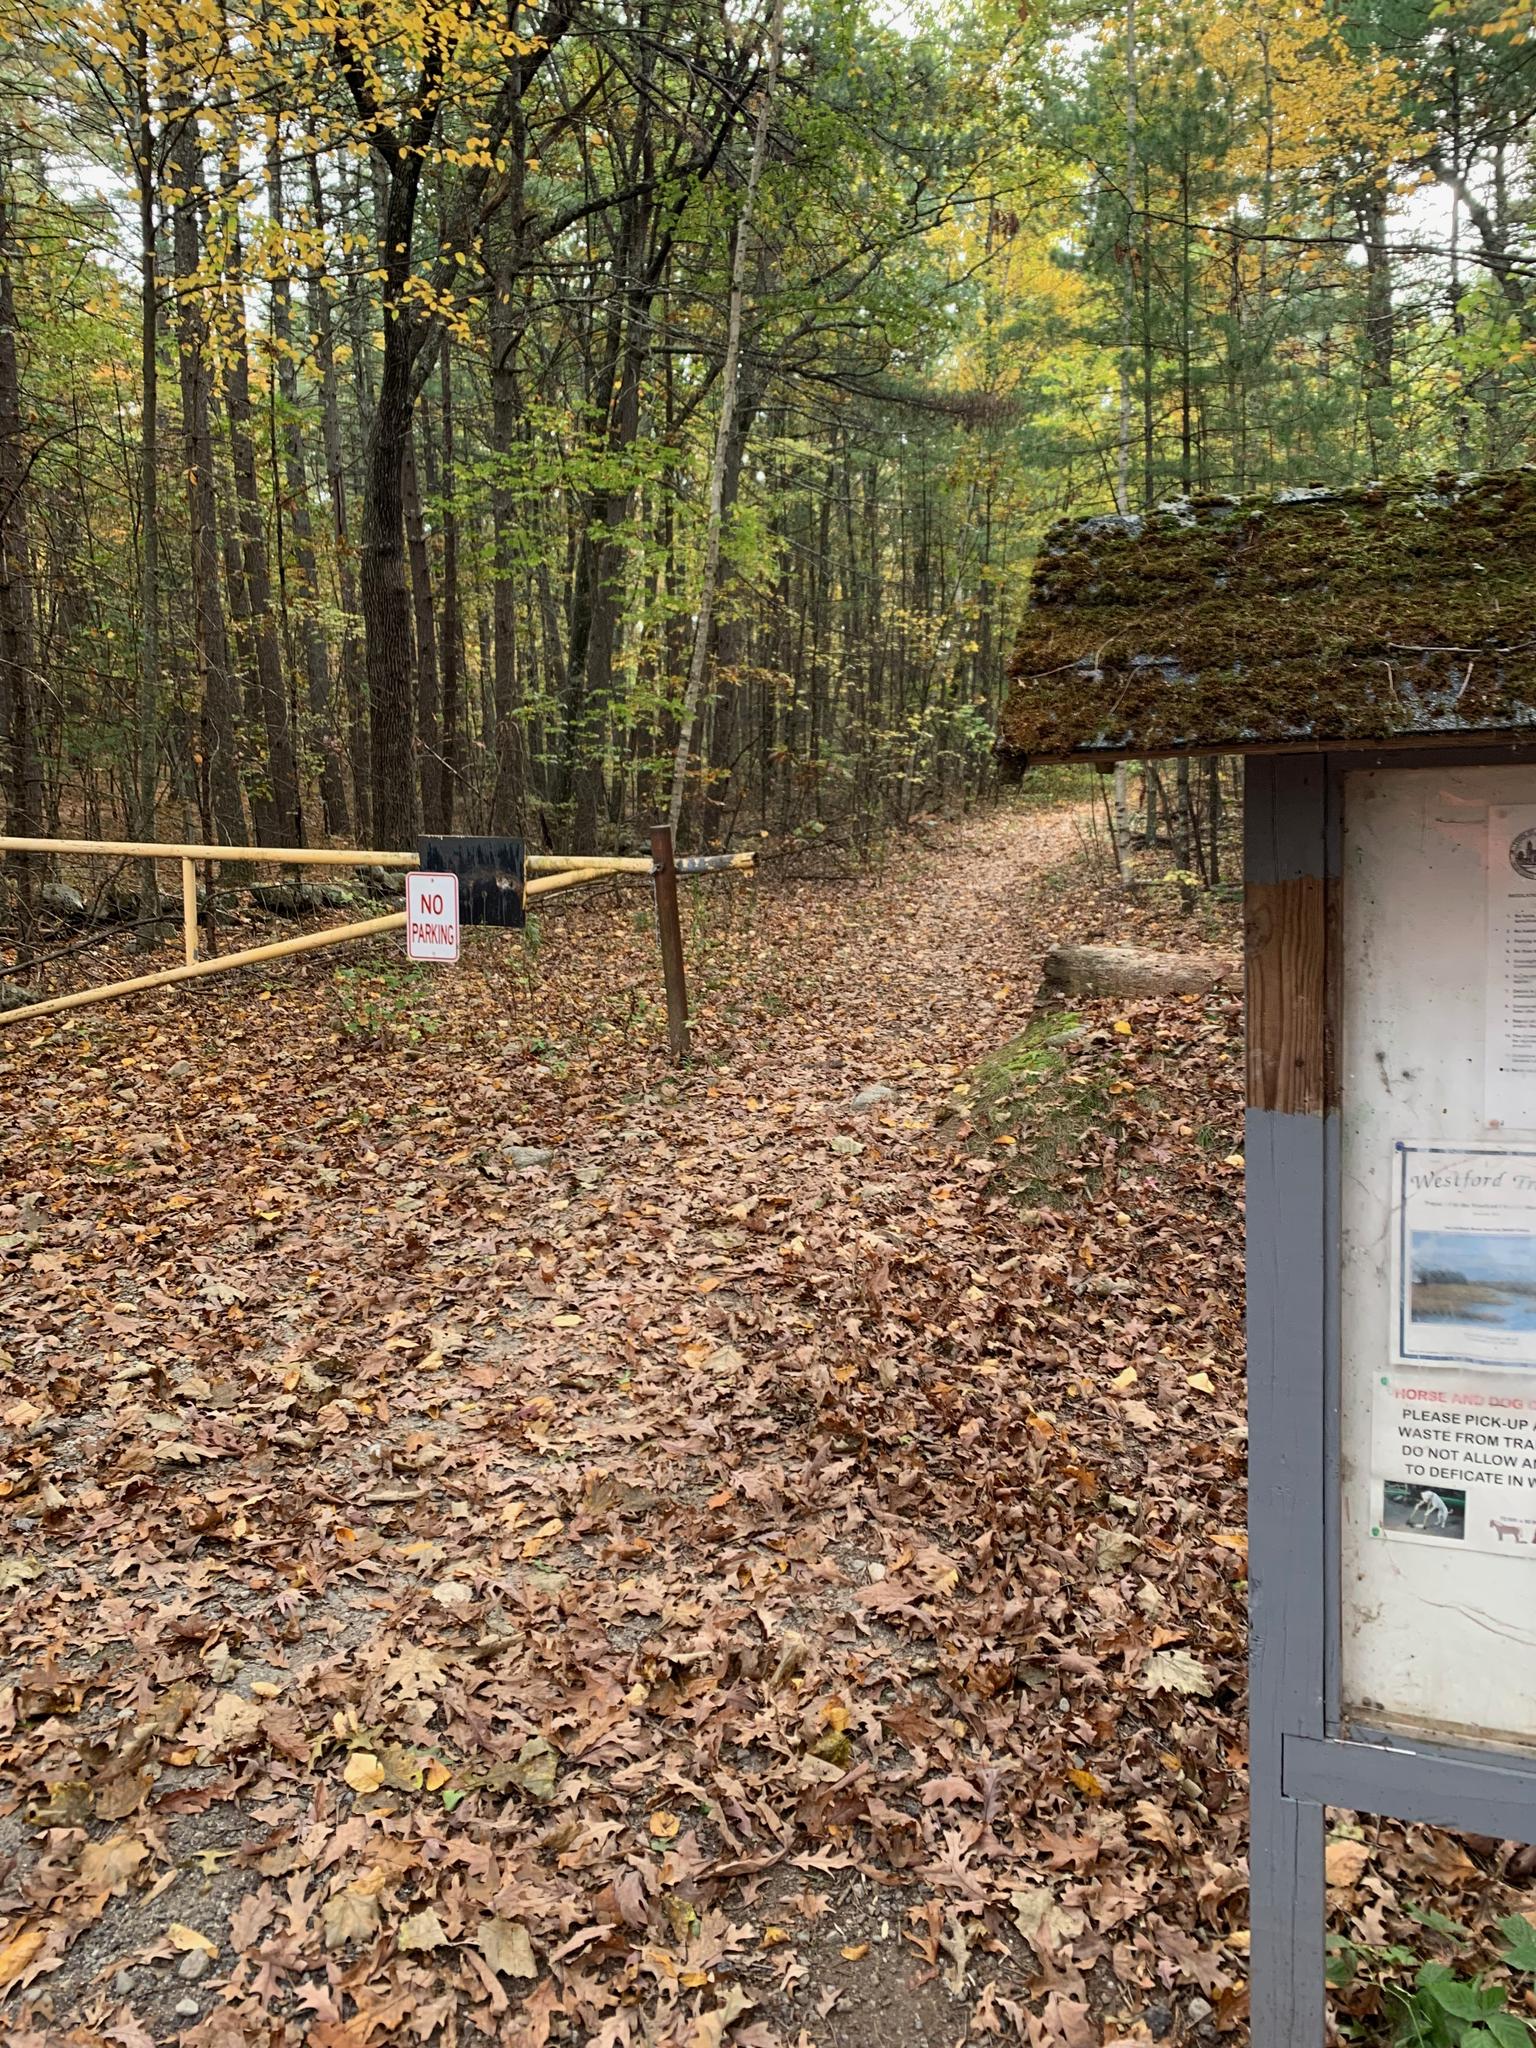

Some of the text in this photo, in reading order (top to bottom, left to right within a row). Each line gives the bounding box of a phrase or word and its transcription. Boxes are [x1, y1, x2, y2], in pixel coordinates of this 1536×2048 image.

[420, 894, 444, 915] NO
[412, 923, 454, 945] PARKING
[1410, 1168, 1536, 1190] Westford Tr
[1395, 1389, 1447, 1403] HORSE
[1452, 1393, 1484, 1406] AND
[1489, 1396, 1524, 1409] DOG
[1402, 1408, 1461, 1424] PLEASE
[1465, 1414, 1529, 1430] PICK-UP
[1398, 1426, 1451, 1441] WASTE
[1455, 1432, 1499, 1447] FROM
[1402, 1445, 1423, 1457] DO
[1428, 1448, 1459, 1461] NOT
[1463, 1451, 1518, 1468] ALLOW
[1405, 1464, 1425, 1476] TO
[1430, 1466, 1503, 1485] DEFICATE
[1508, 1475, 1523, 1487] IN
